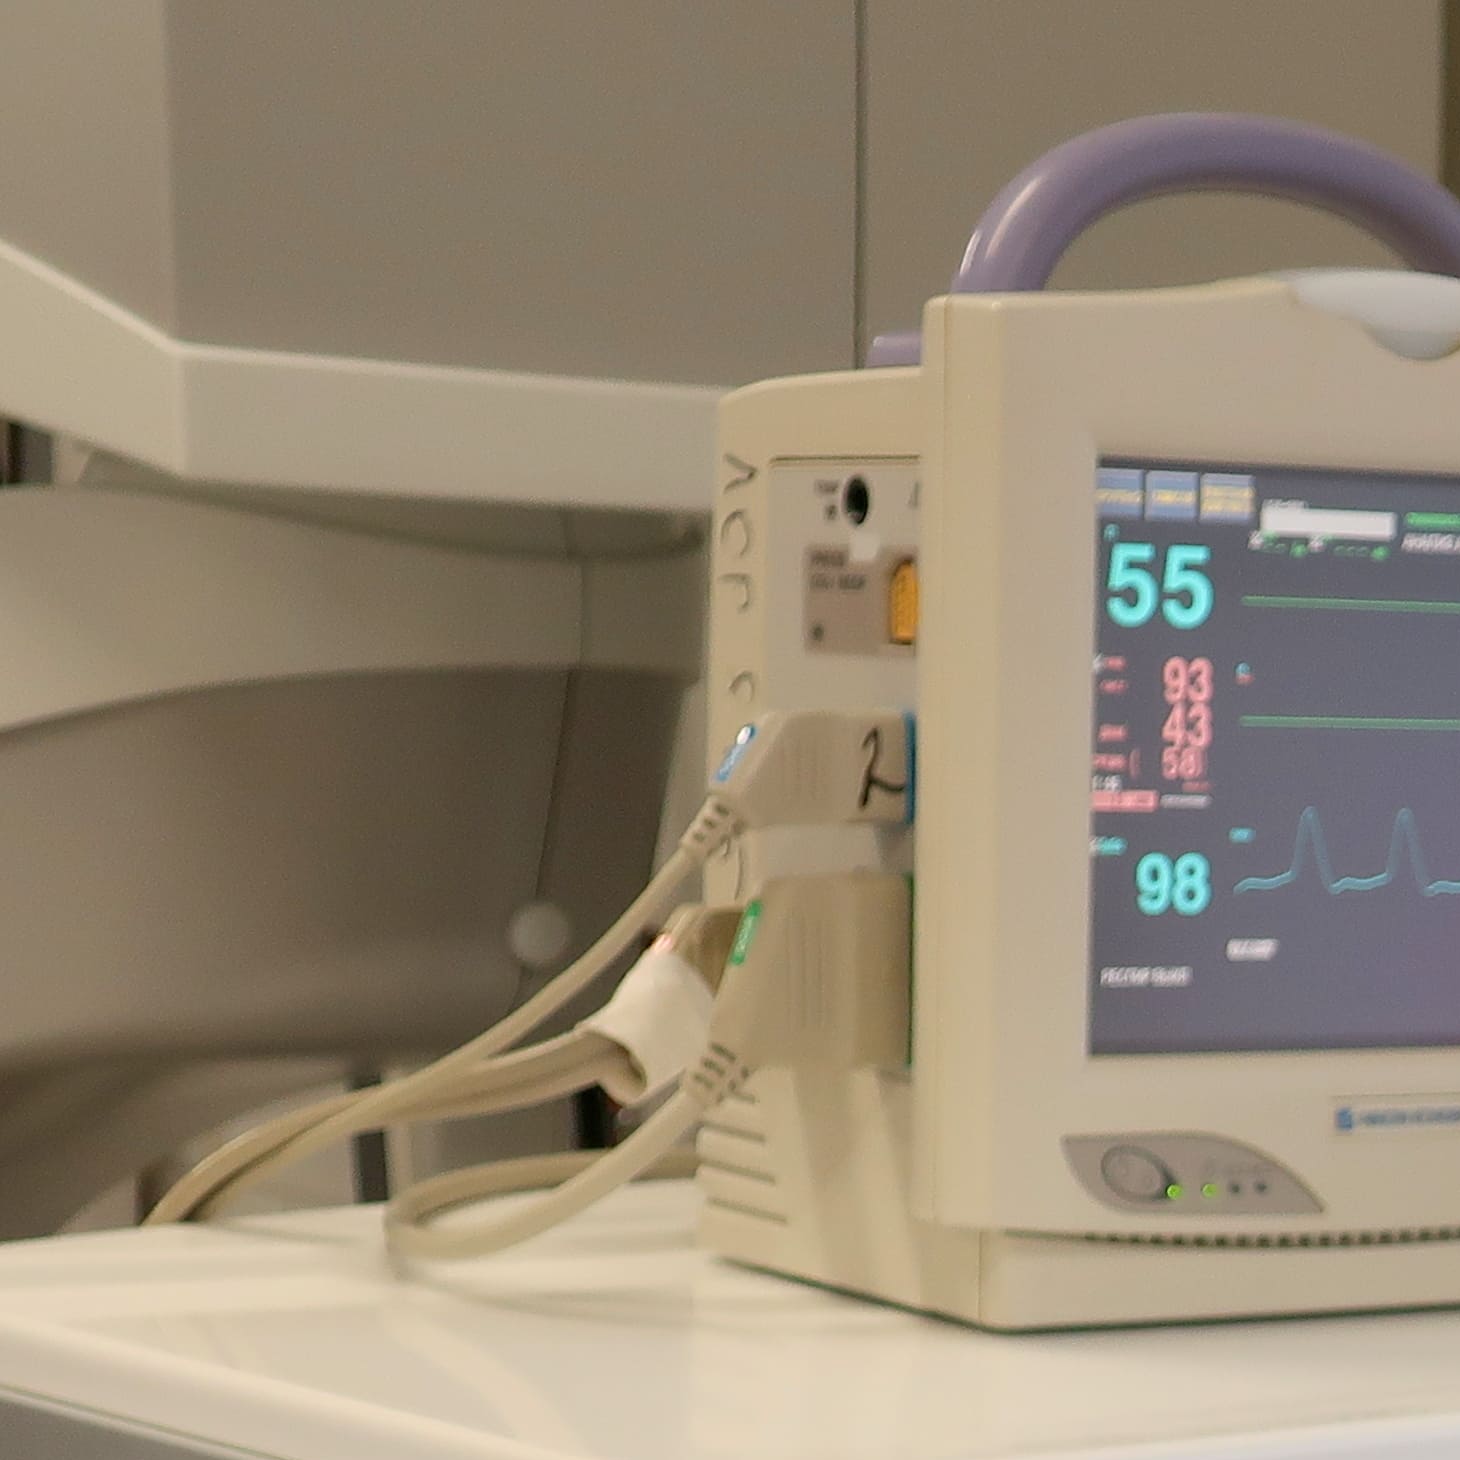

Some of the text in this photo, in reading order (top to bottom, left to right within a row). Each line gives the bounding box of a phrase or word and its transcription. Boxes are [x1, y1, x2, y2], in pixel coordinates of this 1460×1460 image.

[1105, 542, 1214, 629] 55
[1163, 656, 1213, 703] 93
[1161, 702, 1213, 748] 43
[1135, 851, 1212, 917] 98
